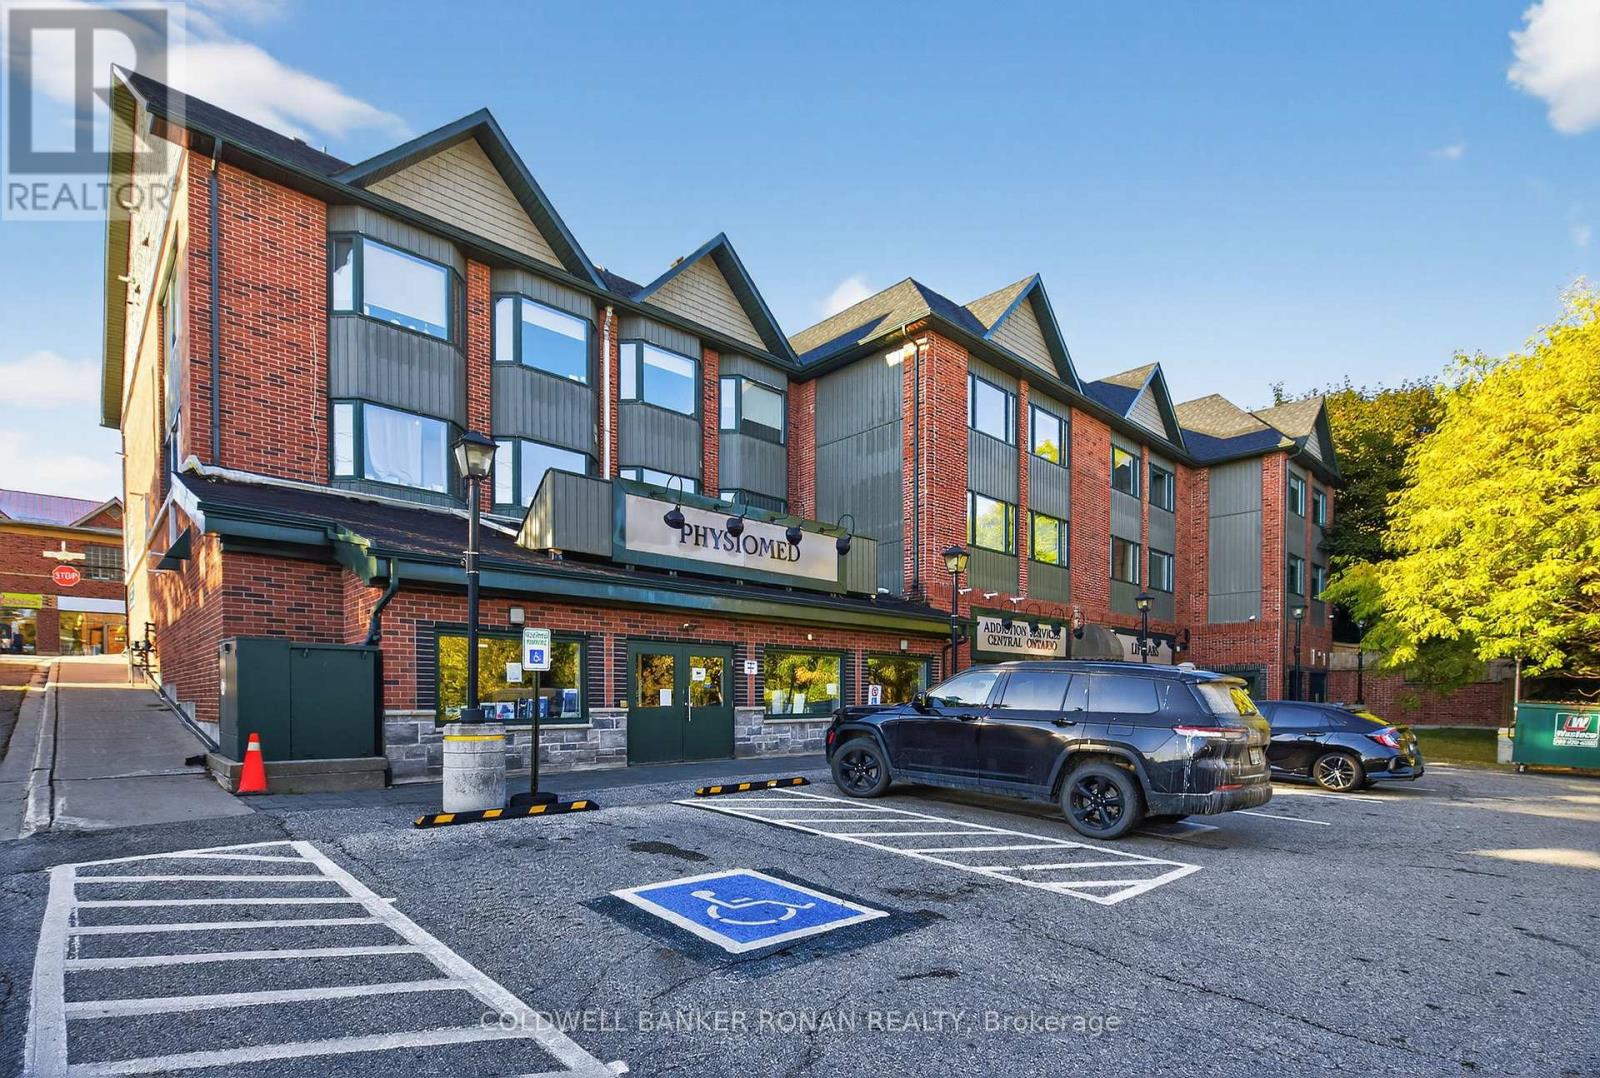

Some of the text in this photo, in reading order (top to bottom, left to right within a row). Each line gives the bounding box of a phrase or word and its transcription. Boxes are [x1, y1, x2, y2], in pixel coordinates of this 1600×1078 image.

[680, 522, 801, 562] PHYSIOMED
[55, 572, 78, 580] STOP
[987, 634, 1058, 651] CENTRAL ONTARIO
